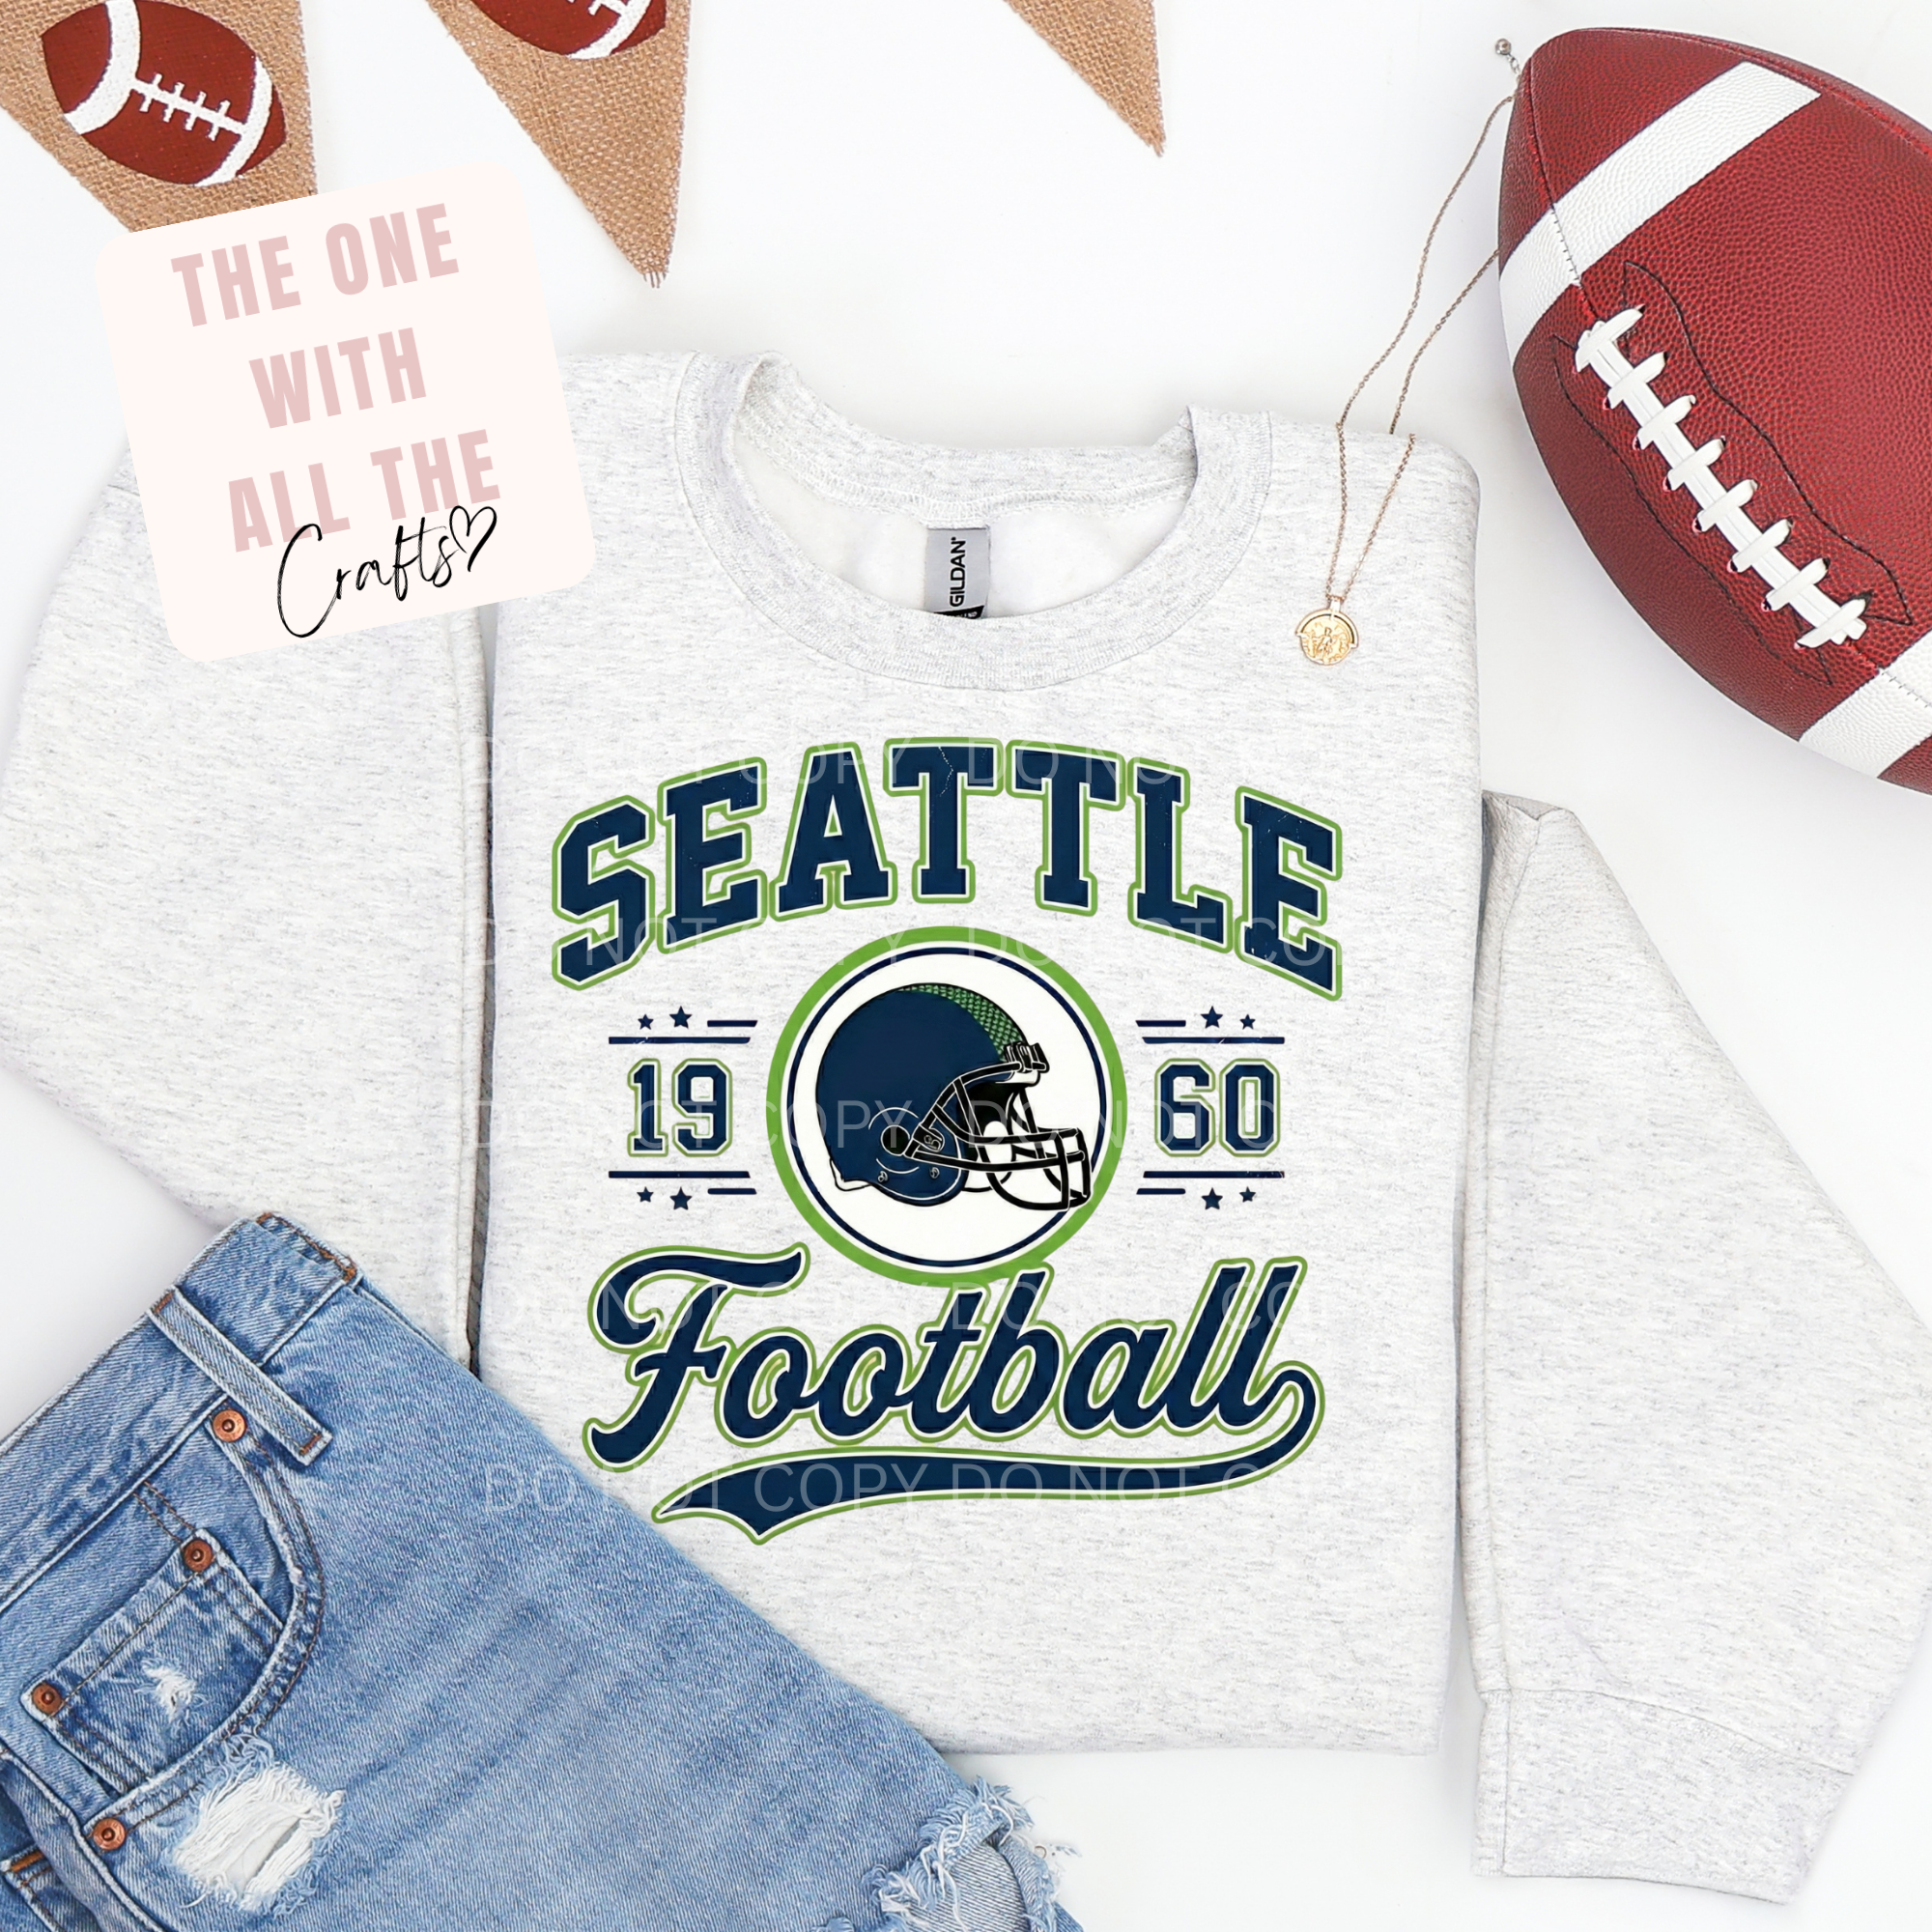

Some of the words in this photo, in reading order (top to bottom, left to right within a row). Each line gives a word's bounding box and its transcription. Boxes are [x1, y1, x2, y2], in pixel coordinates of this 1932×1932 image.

[950, 539, 966, 607] GILDAN
[552, 737, 1342, 1001] SEATTLE
[628, 1058, 732, 1156] 19
[1154, 1058, 1280, 1156] 60
[582, 1242, 1324, 1472] Football
